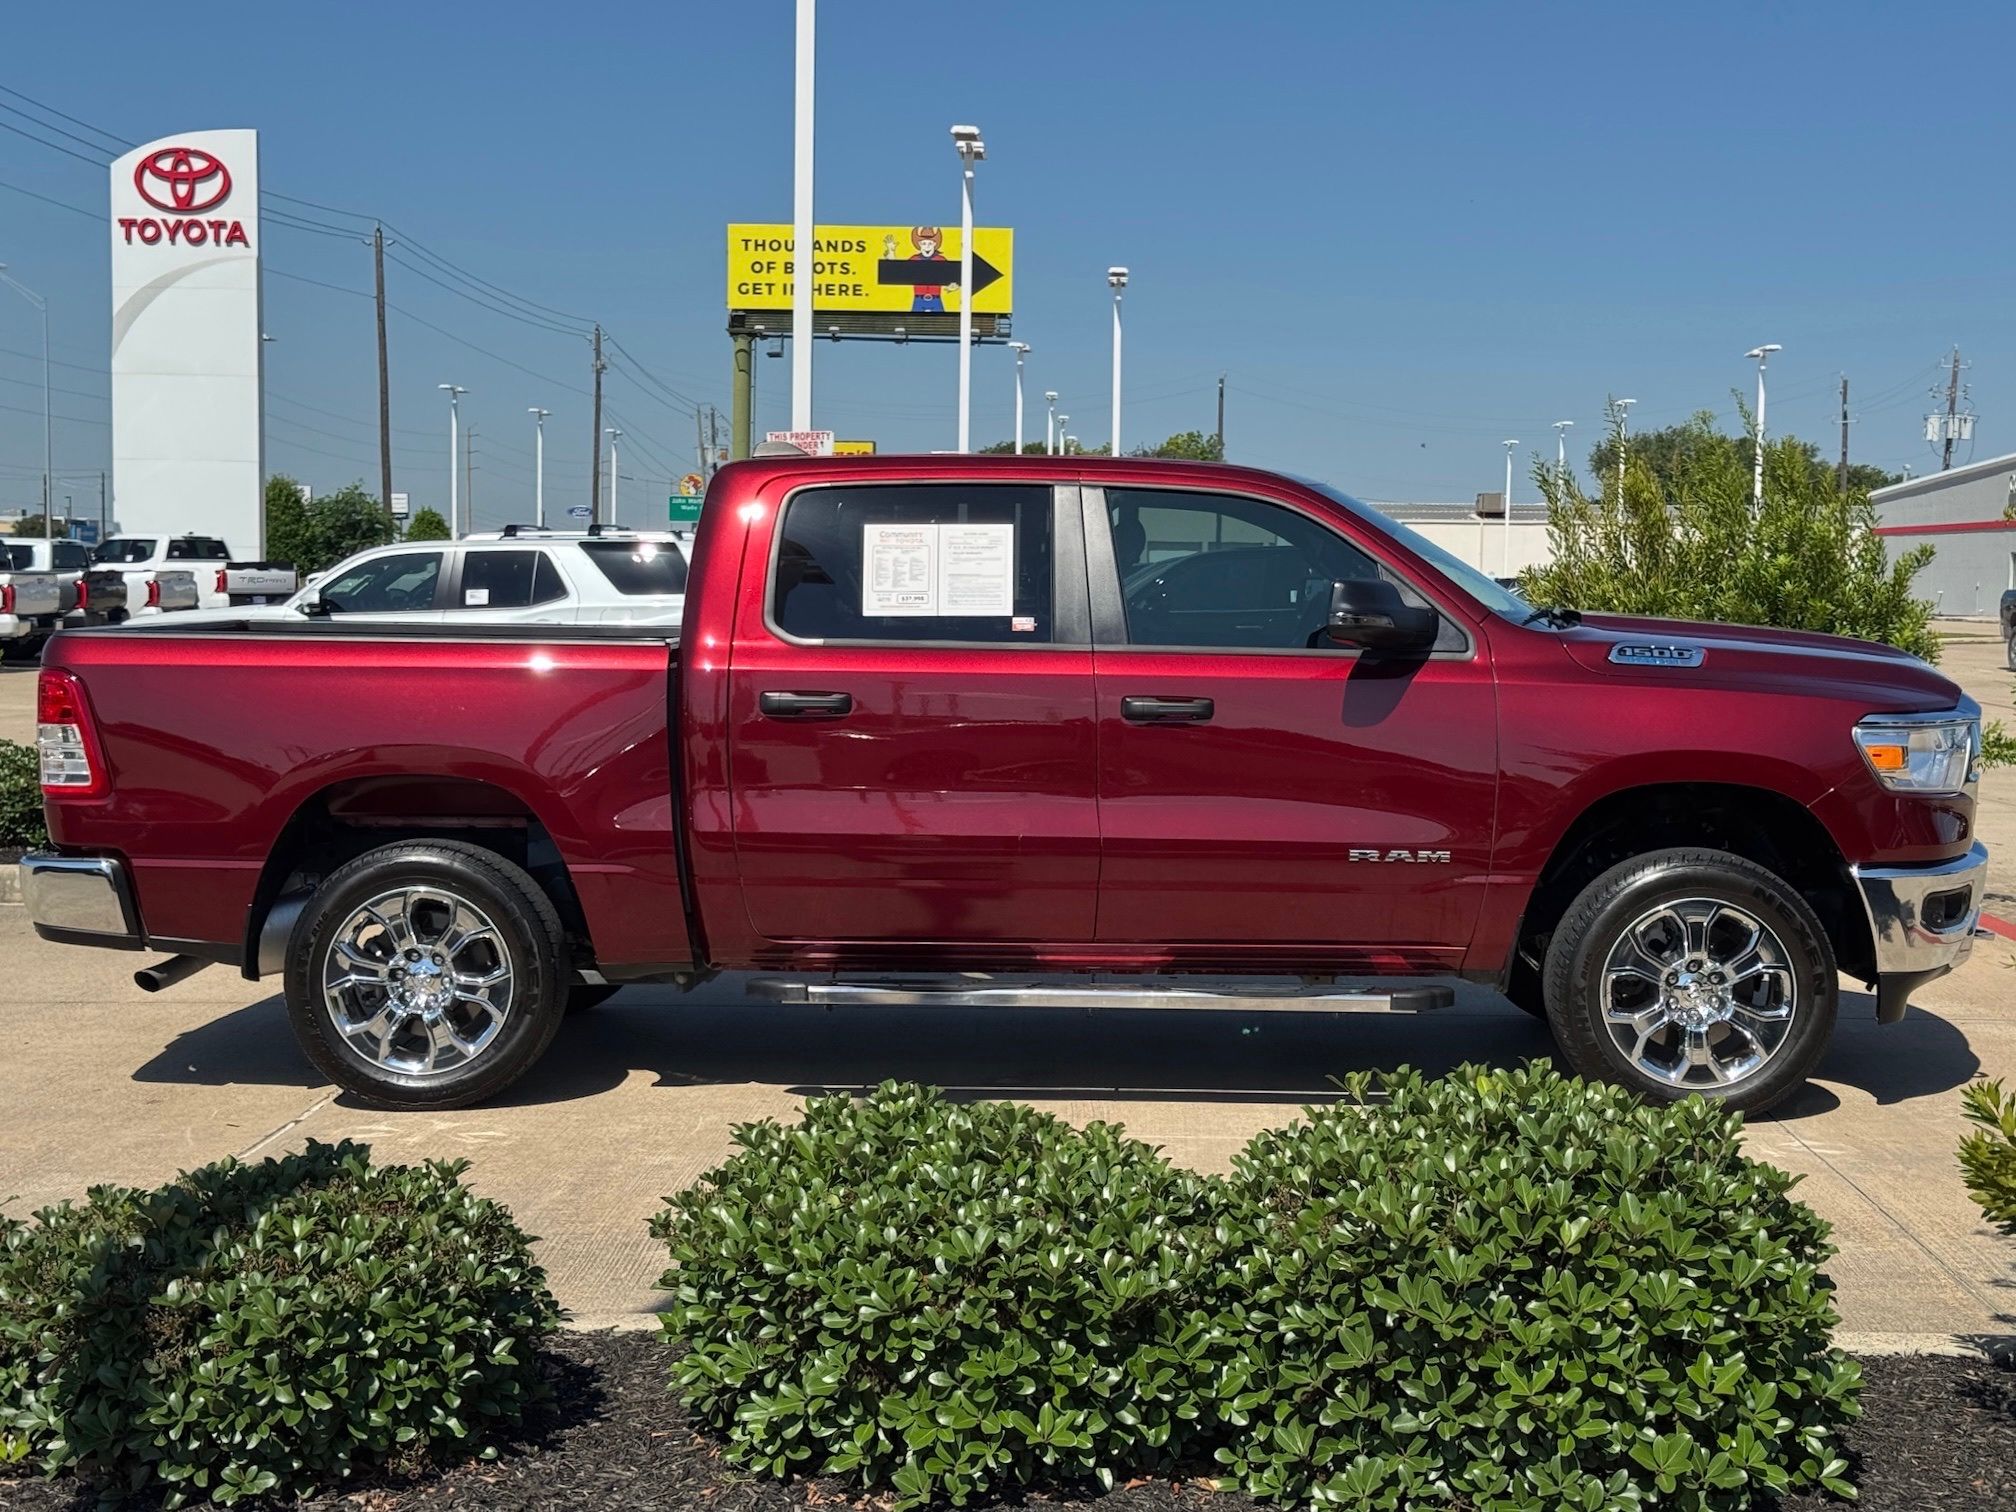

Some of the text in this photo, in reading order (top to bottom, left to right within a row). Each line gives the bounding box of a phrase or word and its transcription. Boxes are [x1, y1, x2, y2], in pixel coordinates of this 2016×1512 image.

[118, 218, 251, 248] TOYOTA
[741, 239, 867, 253] THOUANDS
[750, 261, 856, 275] OF BOTS.
[738, 283, 775, 295] GET
[769, 432, 831, 441] THIS PROPERTY
[1617, 645, 1695, 660] 1500
[1348, 849, 1451, 863] RAM
